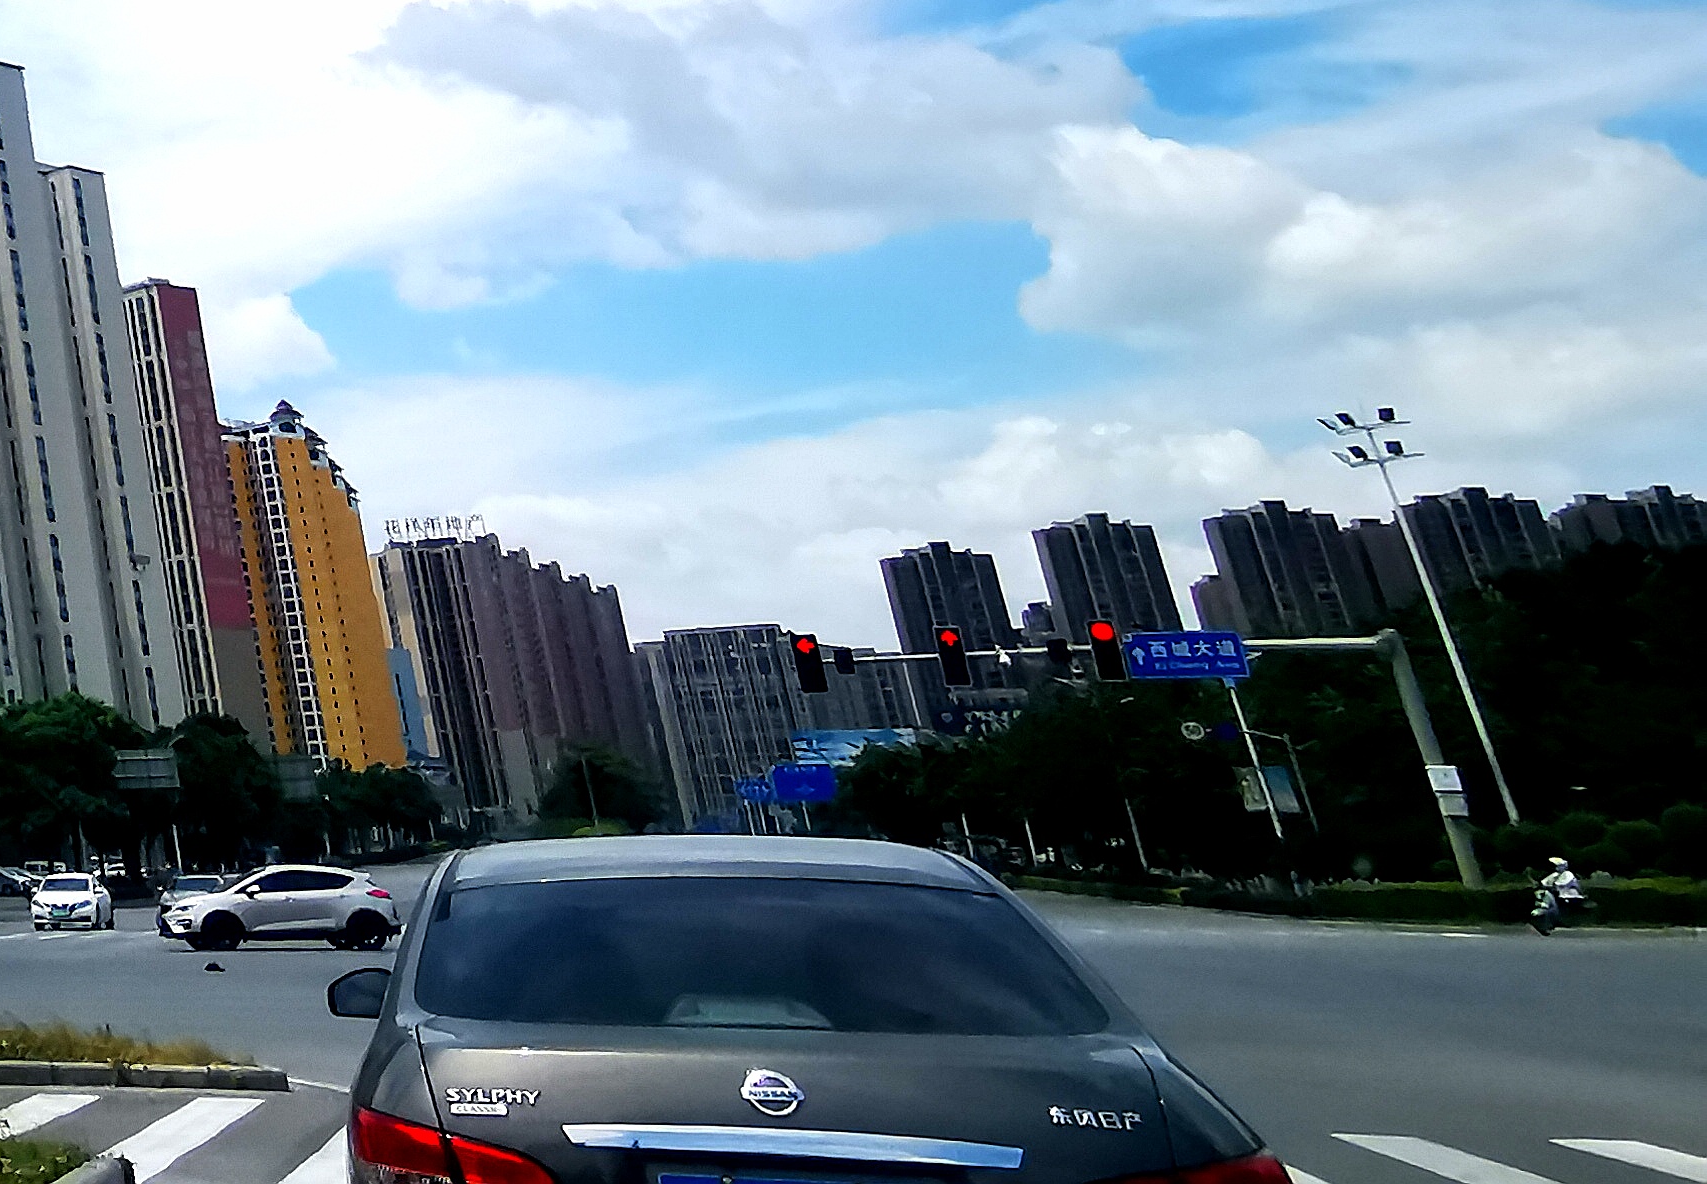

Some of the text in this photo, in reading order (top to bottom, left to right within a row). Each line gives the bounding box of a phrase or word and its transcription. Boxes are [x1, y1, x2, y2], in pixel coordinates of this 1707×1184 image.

[1148, 640, 1237, 657] 西城大道
[446, 1087, 540, 1107] SYLPHY
[747, 1088, 799, 1102] NISSAN
[1048, 1105, 1144, 1131] 东风日产
